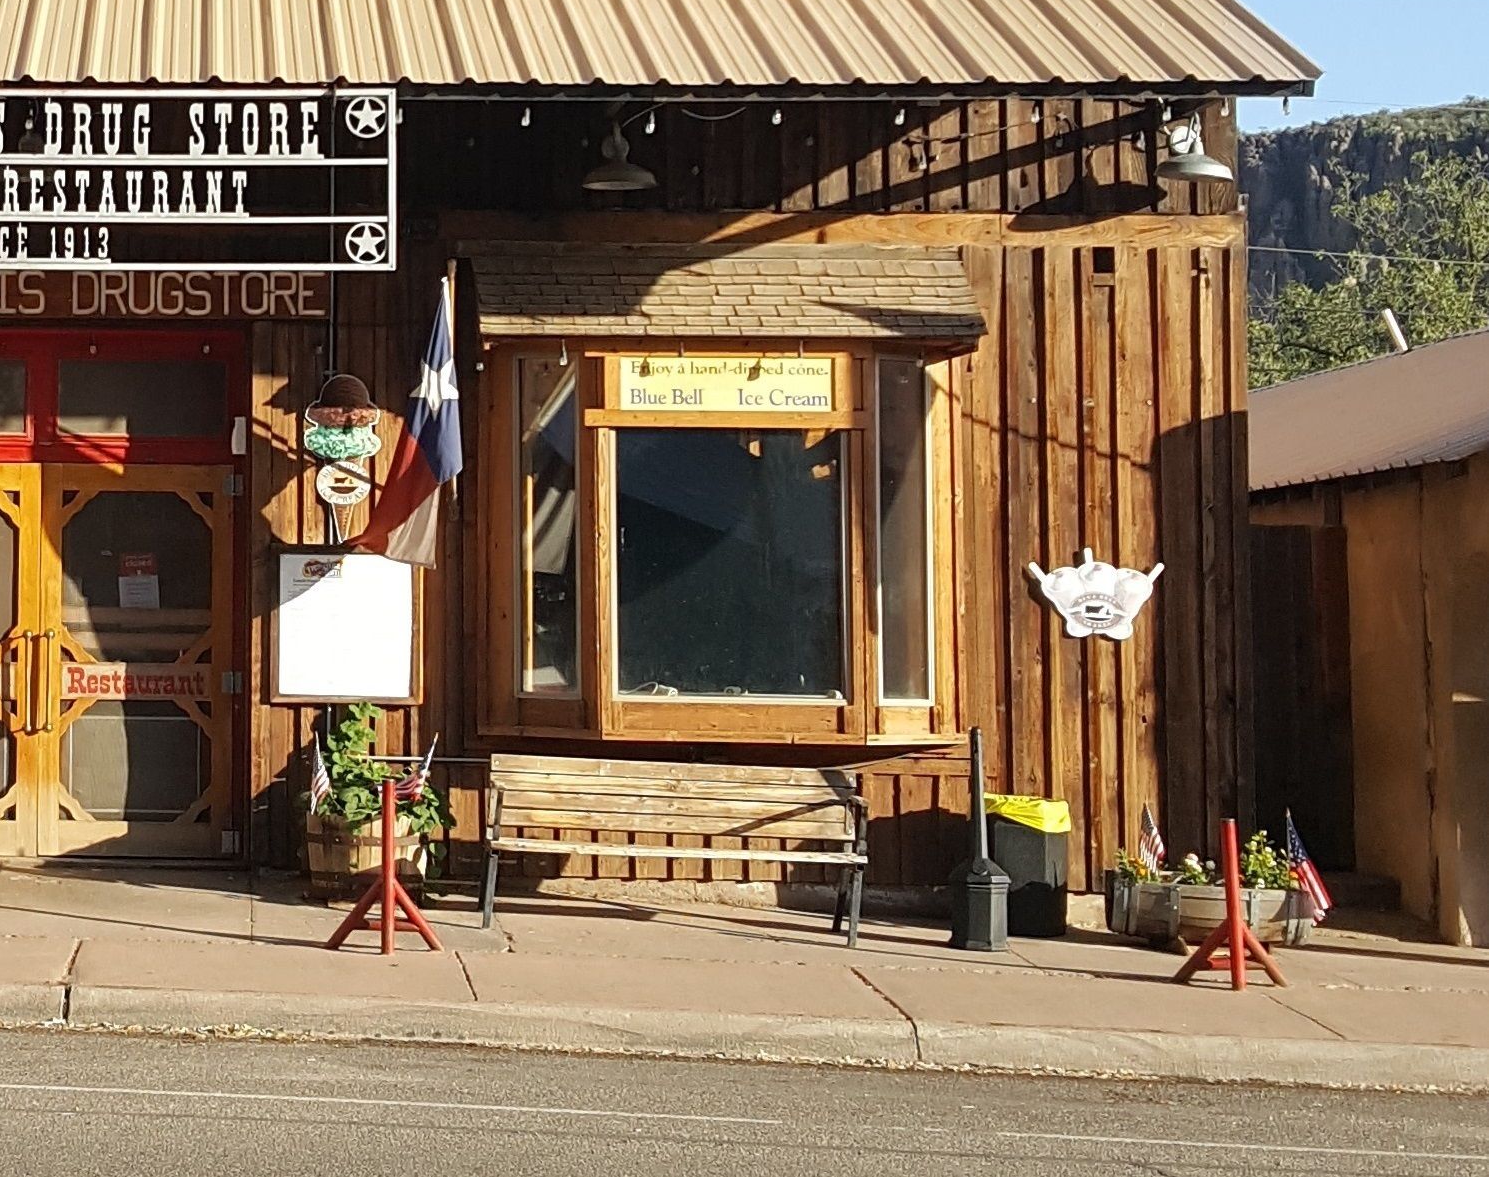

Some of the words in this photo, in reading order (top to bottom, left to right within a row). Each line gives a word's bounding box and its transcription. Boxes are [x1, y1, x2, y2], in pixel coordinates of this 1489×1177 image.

[43, 101, 152, 157] DRUG
[188, 102, 323, 158] STORE
[4, 168, 249, 215] RESTAURANT
[49, 226, 111, 260] 1913
[72, 271, 325, 315] DRUGSTORE
[630, 388, 667, 405] Blue
[671, 388, 704, 405] Bell
[738, 388, 763, 406] Ice
[769, 389, 829, 407] Cream
[67, 667, 205, 695] Restaurant
